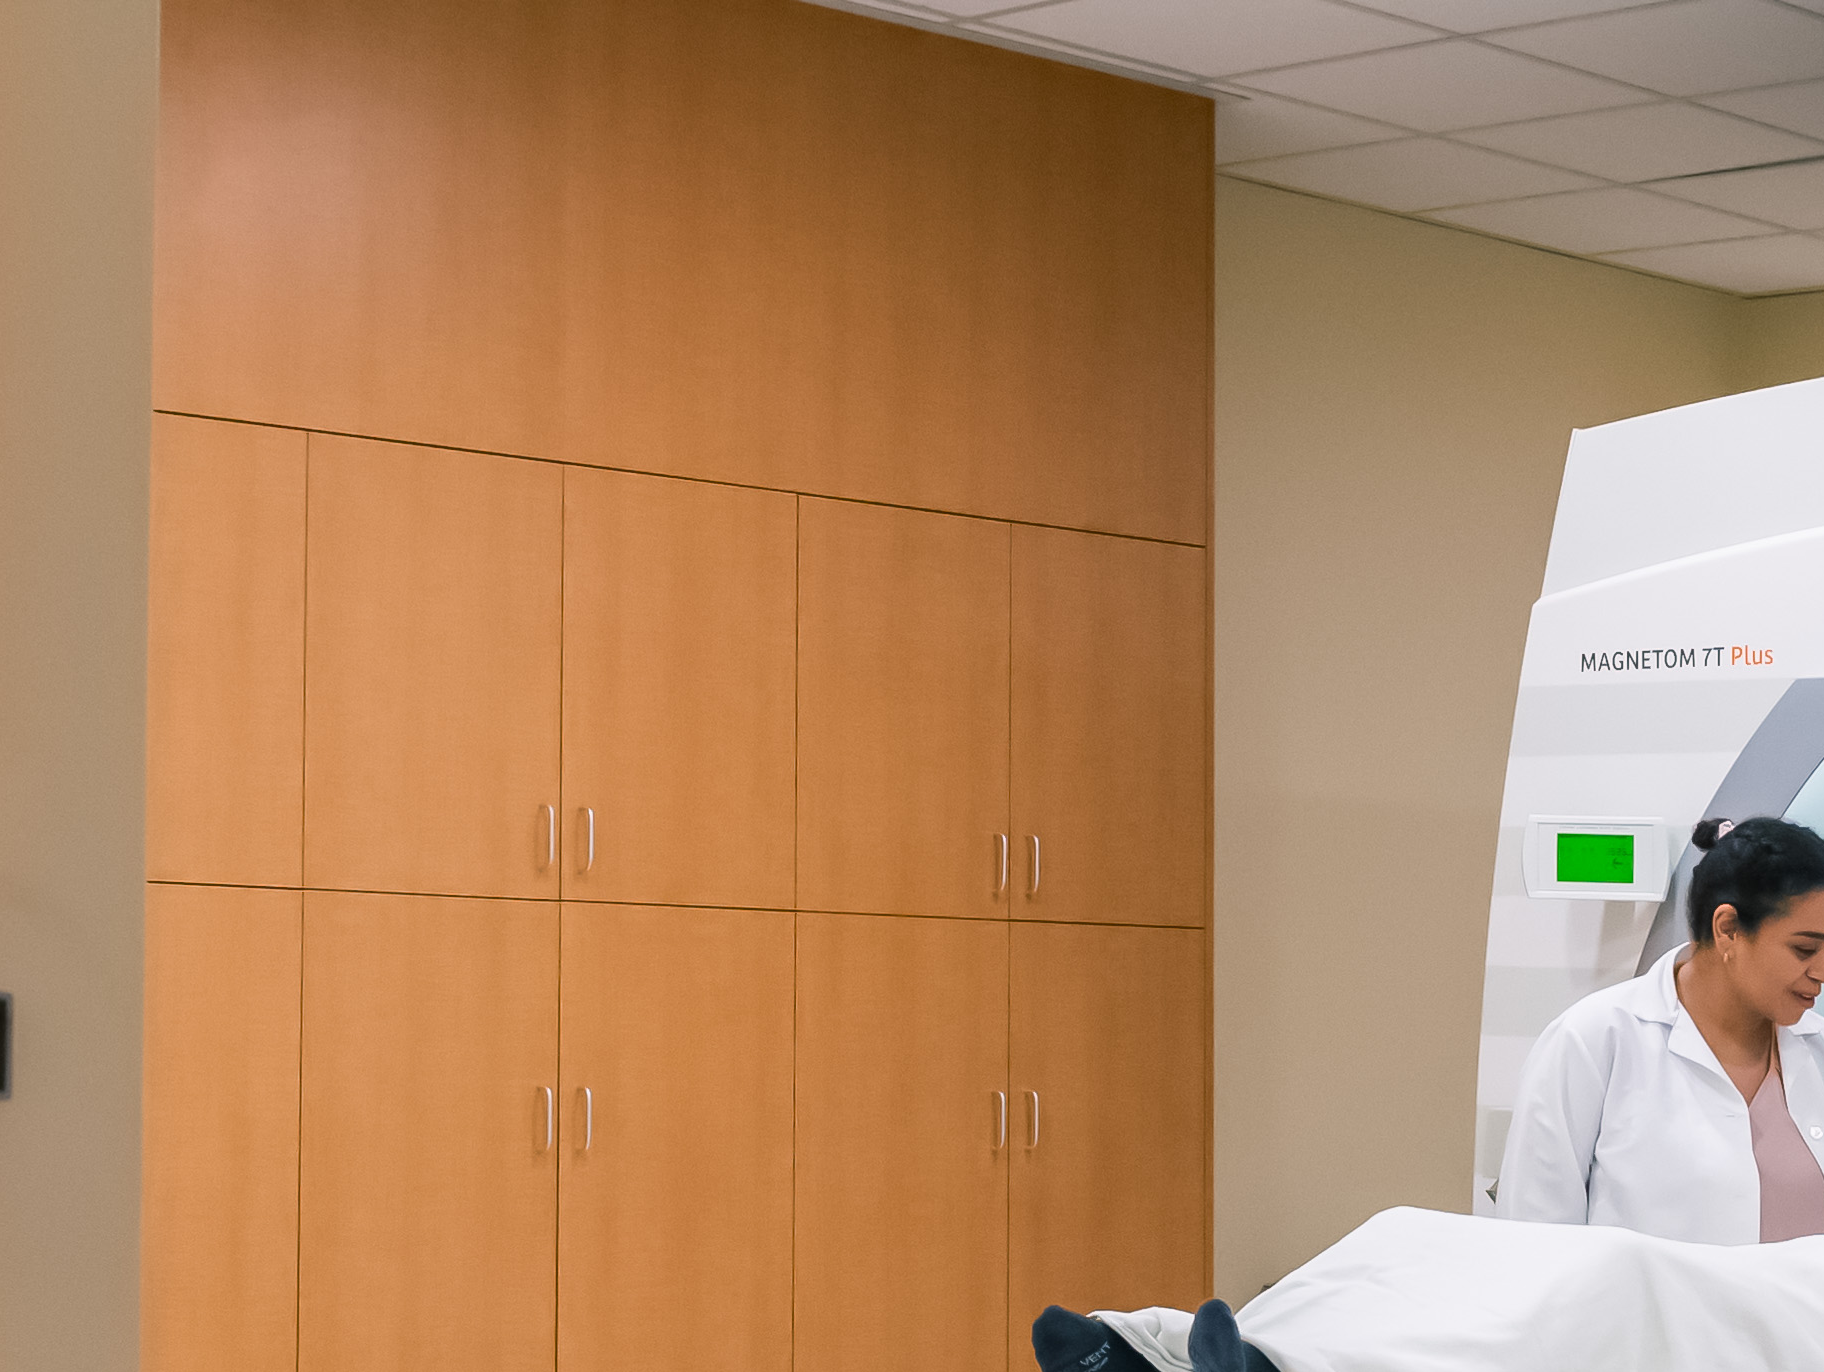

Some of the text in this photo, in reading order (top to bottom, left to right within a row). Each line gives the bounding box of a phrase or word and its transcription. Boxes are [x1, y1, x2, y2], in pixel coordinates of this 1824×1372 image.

[1580, 645, 1774, 673] MAGNETOM 7T Plus
[1079, 1340, 1111, 1367] VENT
